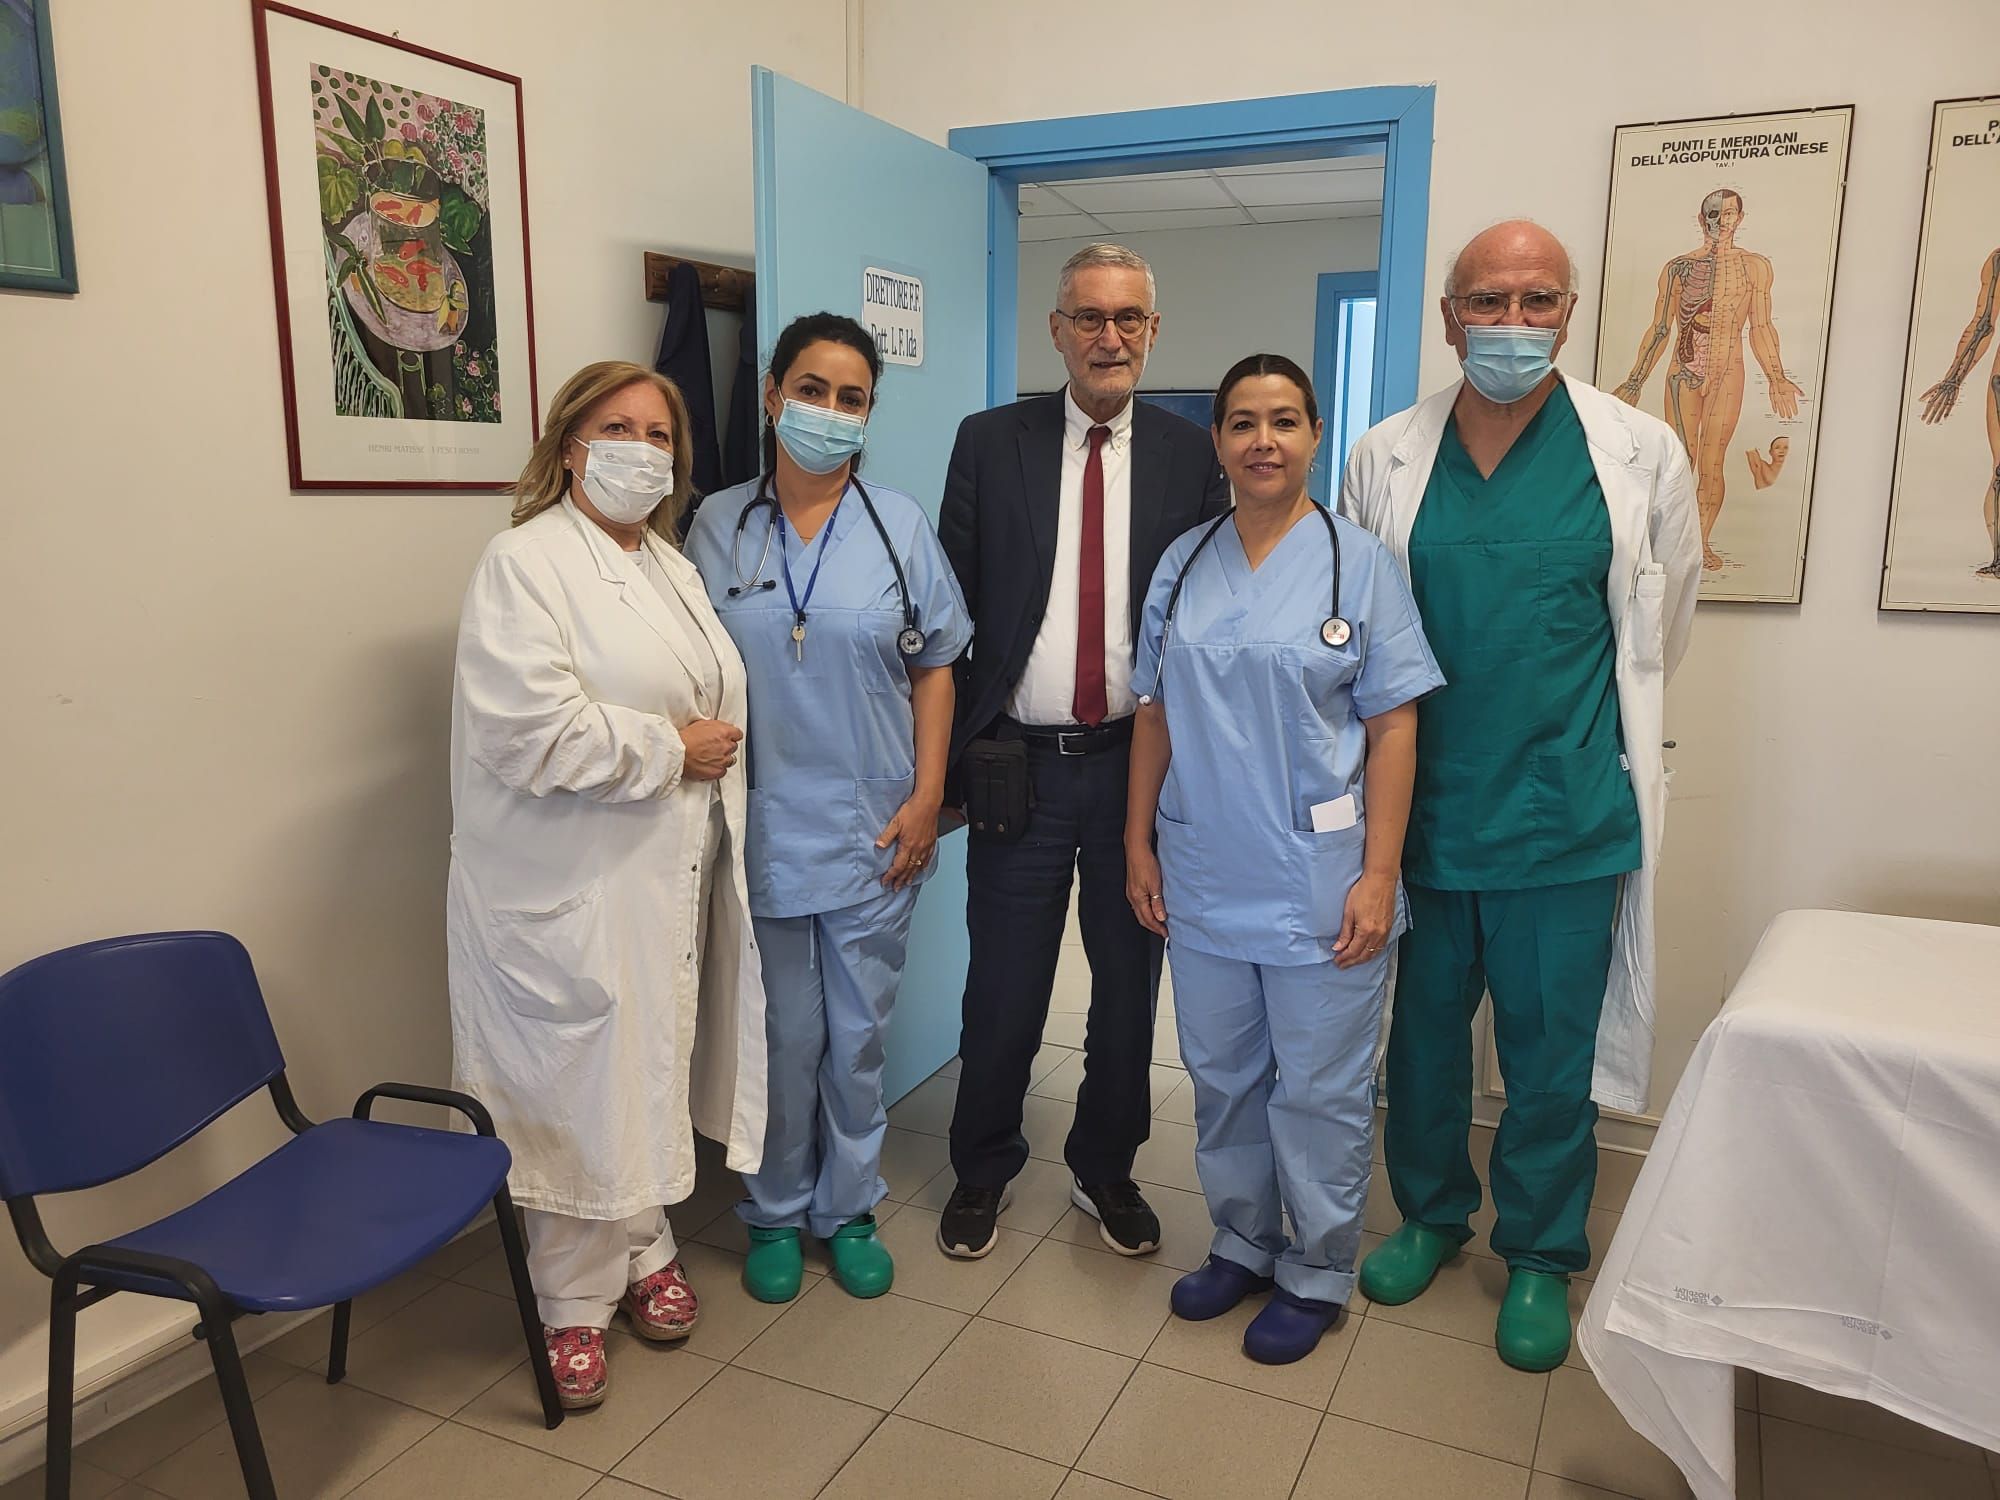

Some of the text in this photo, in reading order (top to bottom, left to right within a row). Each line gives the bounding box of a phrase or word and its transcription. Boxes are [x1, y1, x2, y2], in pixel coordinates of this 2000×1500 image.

[1988, 119, 2000, 131] P
[1662, 132, 1798, 153] PUNTI E MERIDIANI
[1631, 142, 1829, 167] DELL'AGOPUNTURA CINESE
[866, 272, 908, 310] DIRETTORE
